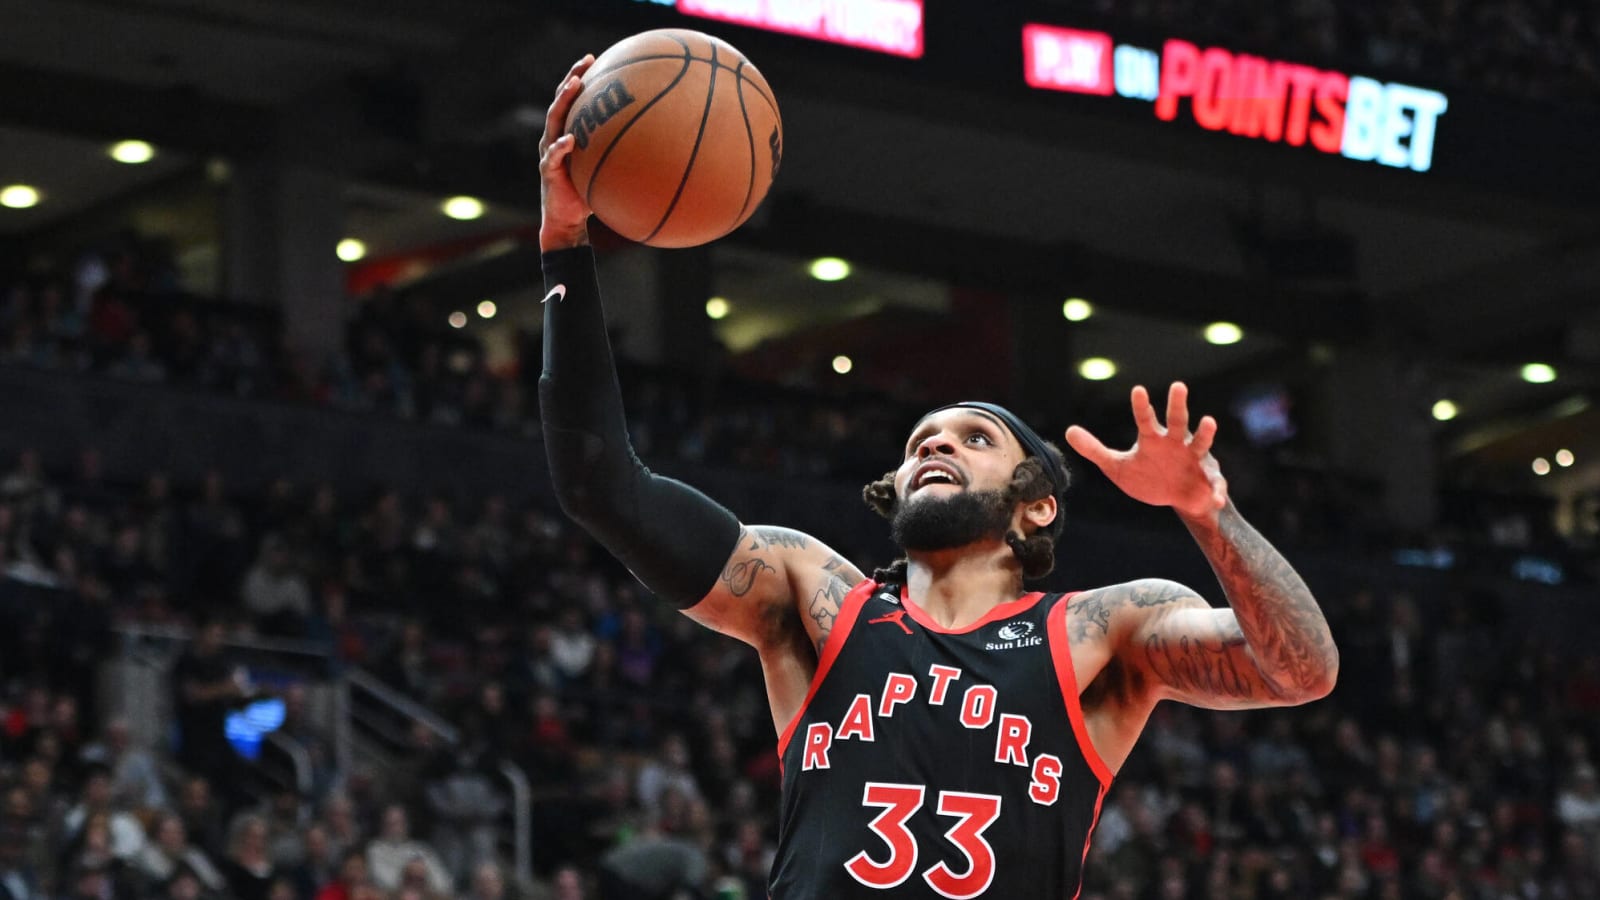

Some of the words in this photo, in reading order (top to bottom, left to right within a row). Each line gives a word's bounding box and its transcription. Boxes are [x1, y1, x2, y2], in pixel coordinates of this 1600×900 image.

[1154, 38, 1448, 172] POINTSBET
[985, 642, 1013, 650] Sun
[1016, 636, 1042, 648] Life
[802, 664, 1063, 806] RAPTORS
[843, 782, 1002, 900] 33
